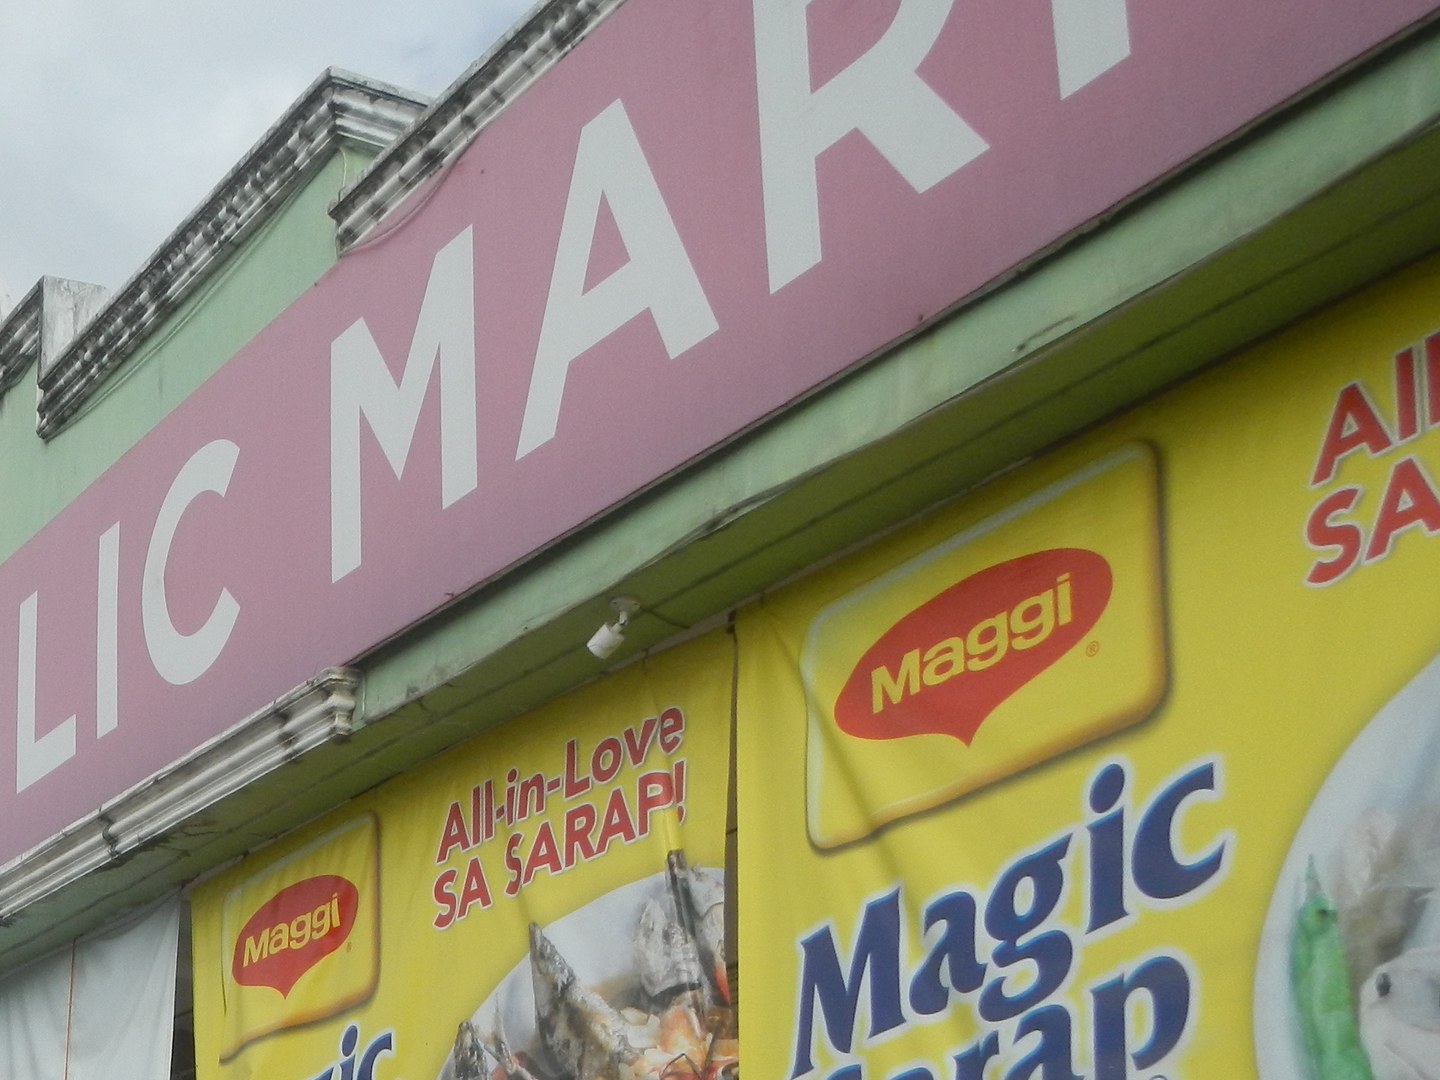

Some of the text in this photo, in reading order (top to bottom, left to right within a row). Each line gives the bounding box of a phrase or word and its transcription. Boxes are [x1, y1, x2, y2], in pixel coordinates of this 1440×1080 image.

[331, 0, 1131, 584] MAR
[870, 572, 1074, 714] Maggi
[433, 761, 686, 930] SA SARAP!
[435, 704, 684, 864] All-in-Love
[243, 893, 341, 968] Maggi
